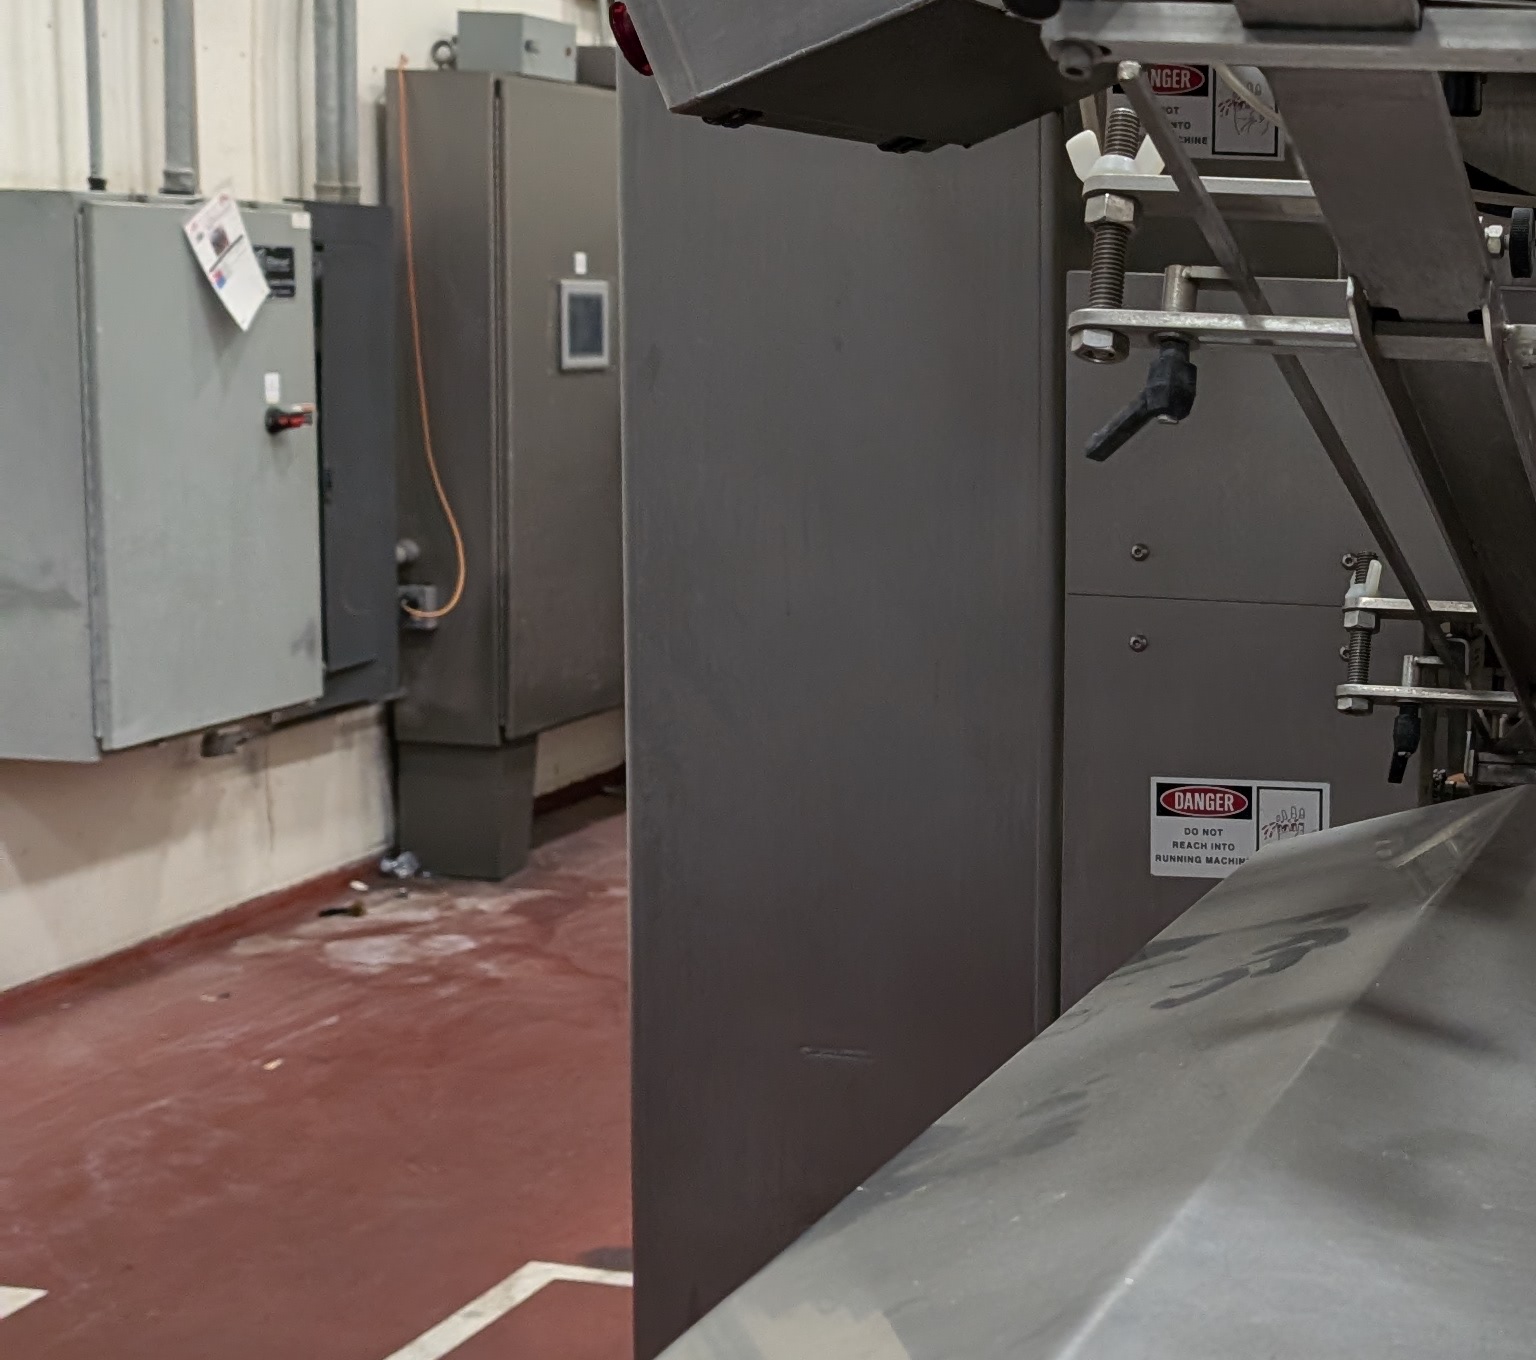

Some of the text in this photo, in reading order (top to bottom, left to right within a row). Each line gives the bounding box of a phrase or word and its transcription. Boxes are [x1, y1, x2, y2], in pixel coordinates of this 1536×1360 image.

[1150, 68, 1191, 88] NGER
[1174, 792, 1234, 812] DANGER
[1184, 827, 1223, 837] DO NOT
[1172, 841, 1235, 851] REACH INTO
[1155, 854, 1249, 865] RUNNING MACHIN
